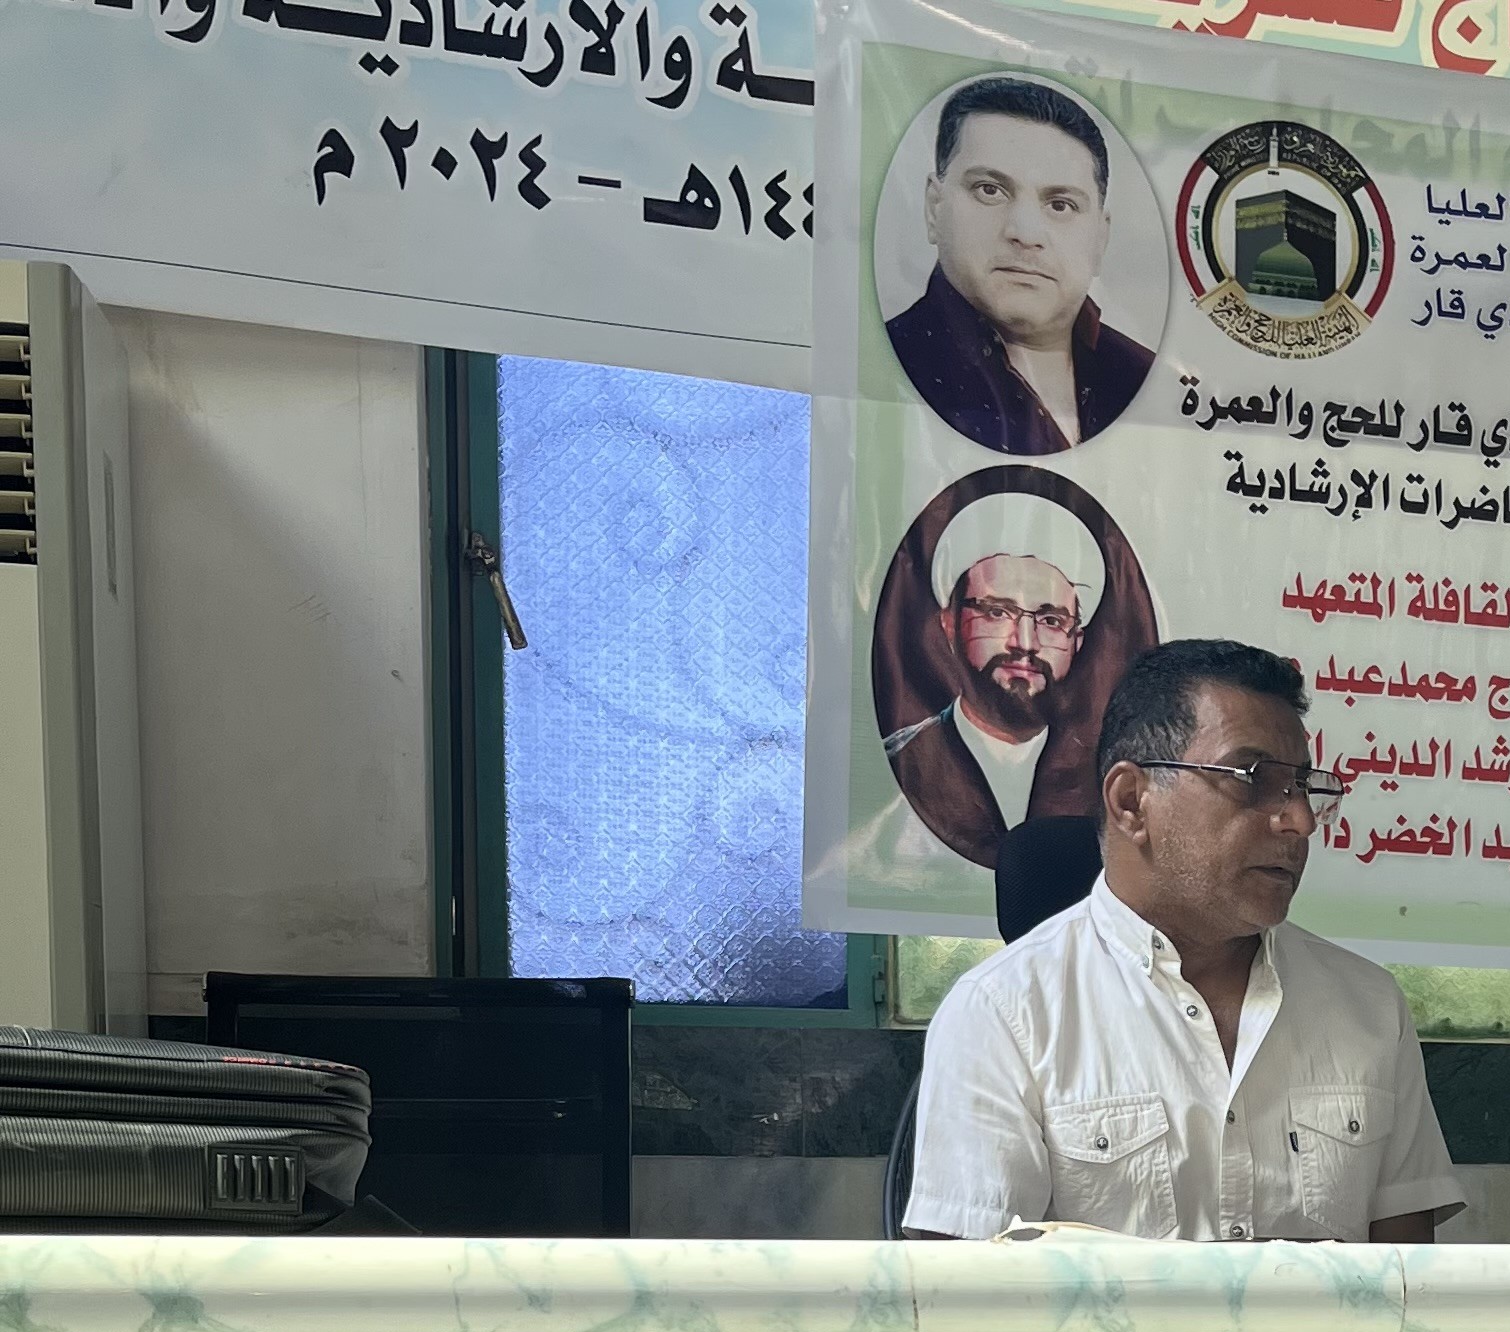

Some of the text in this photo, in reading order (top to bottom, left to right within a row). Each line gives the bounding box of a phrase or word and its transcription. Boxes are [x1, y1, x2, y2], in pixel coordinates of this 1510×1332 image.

[314, 129, 354, 205] م
[380, 116, 551, 210] ٢٠٢٤
[1411, 288, 1465, 326] قار
[1180, 376, 1313, 439] والعمرة
[1323, 399, 1405, 447] للحج
[1407, 402, 1472, 451] قار
[1224, 450, 1389, 520] الإرشادية
[1282, 571, 1396, 623] المتعهد
[1334, 731, 1451, 793] الديني
[1357, 814, 1471, 863] الخضر
